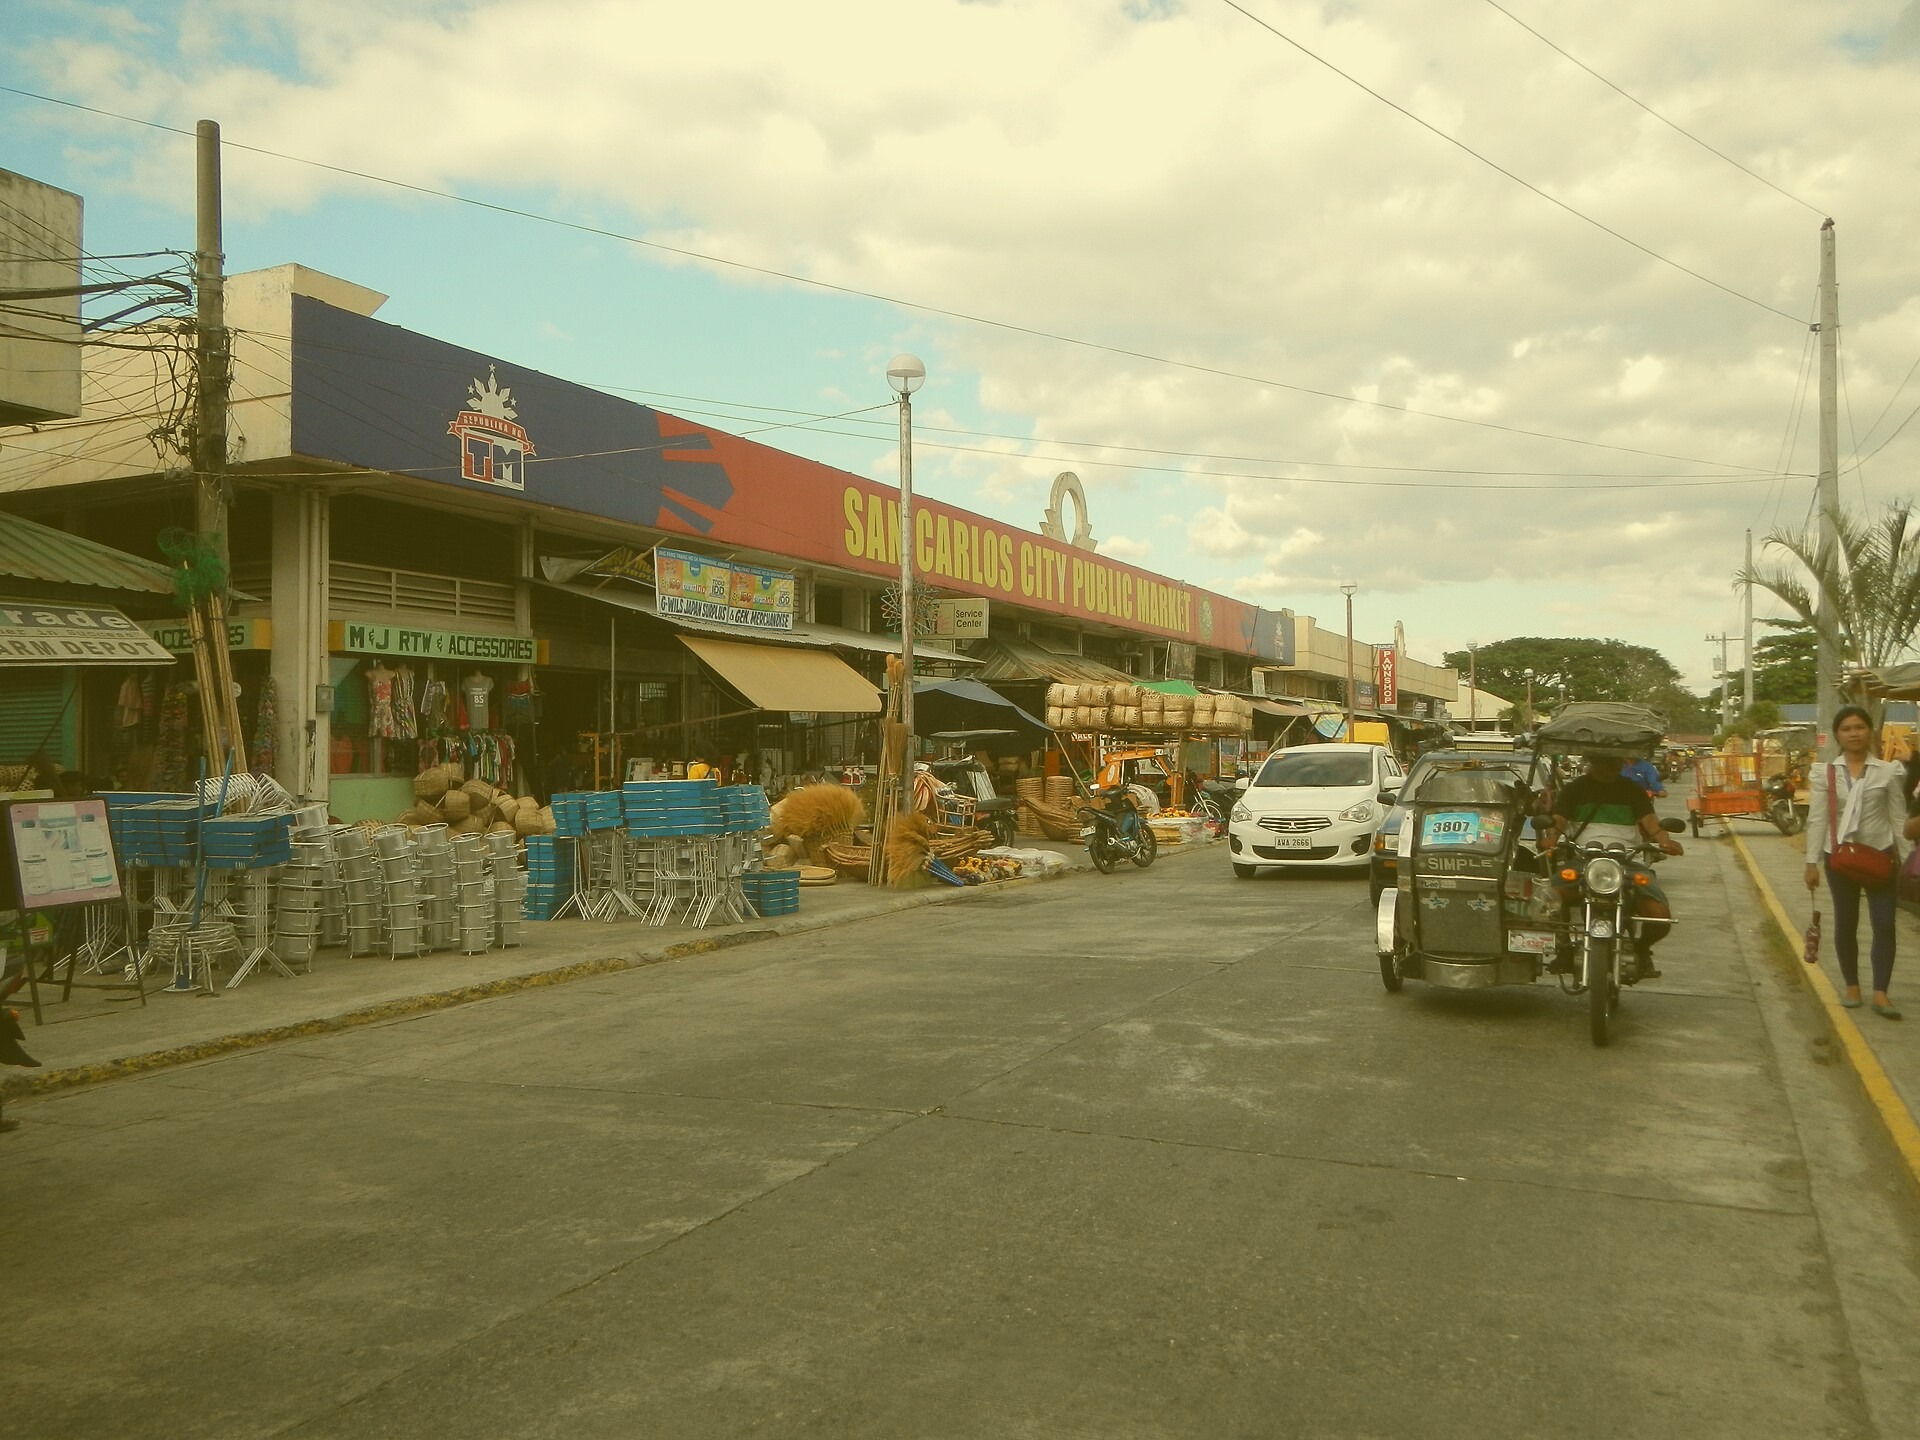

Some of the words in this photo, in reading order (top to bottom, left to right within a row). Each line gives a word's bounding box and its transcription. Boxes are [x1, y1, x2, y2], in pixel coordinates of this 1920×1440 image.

[463, 415, 509, 433] REPUBLIKA
[511, 428, 523, 438] NG
[843, 486, 902, 566] SAN
[916, 508, 1014, 592] CARLOS
[1020, 541, 1067, 604] CITY
[1073, 558, 1133, 620] PUBLIC
[1136, 578, 1192, 633] MARKET
[702, 602, 727, 621] SURPLUS
[750, 610, 789, 628] MERCHANDISE
[956, 609, 983, 618] Service
[956, 619, 982, 628] Center
[60, 640, 155, 656] DEPOT
[400, 631, 432, 653] RTW
[449, 635, 533, 660] ACCESSORIES
[1382, 650, 1393, 704] PAWNSHOP
[1433, 821, 1470, 833] 3807
[1278, 838, 1290, 846] AWA
[1427, 857, 1493, 871] SIMPLE
